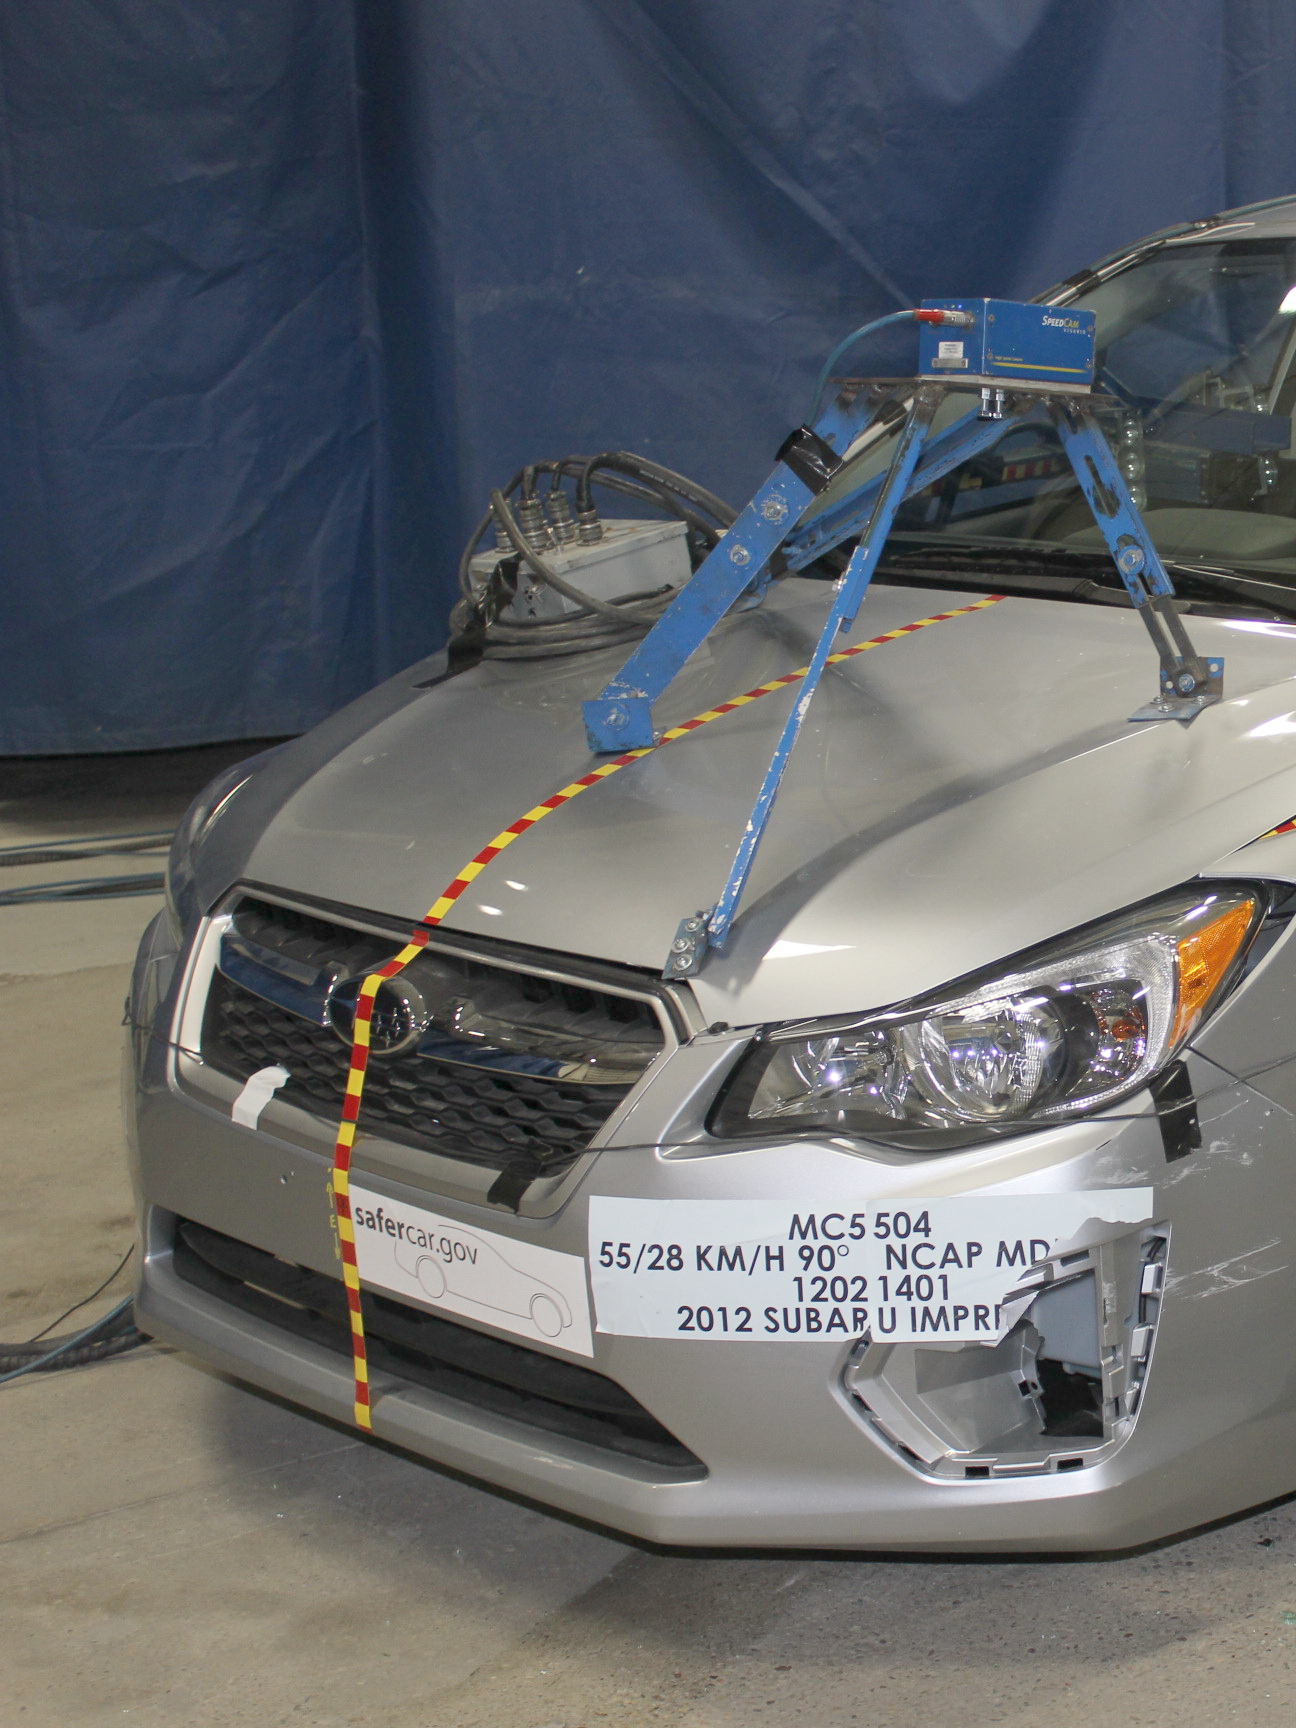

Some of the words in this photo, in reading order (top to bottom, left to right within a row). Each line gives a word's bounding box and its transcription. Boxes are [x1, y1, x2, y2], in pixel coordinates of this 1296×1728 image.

[355, 1206, 479, 1265] safercar.gov
[598, 1241, 684, 1274] 55/28
[696, 1245, 785, 1276] KM/H
[798, 1244, 849, 1272] 90°
[885, 1242, 983, 1271] NCAP
[996, 1238, 1057, 1268] MD
[677, 1305, 753, 1333] 2012
